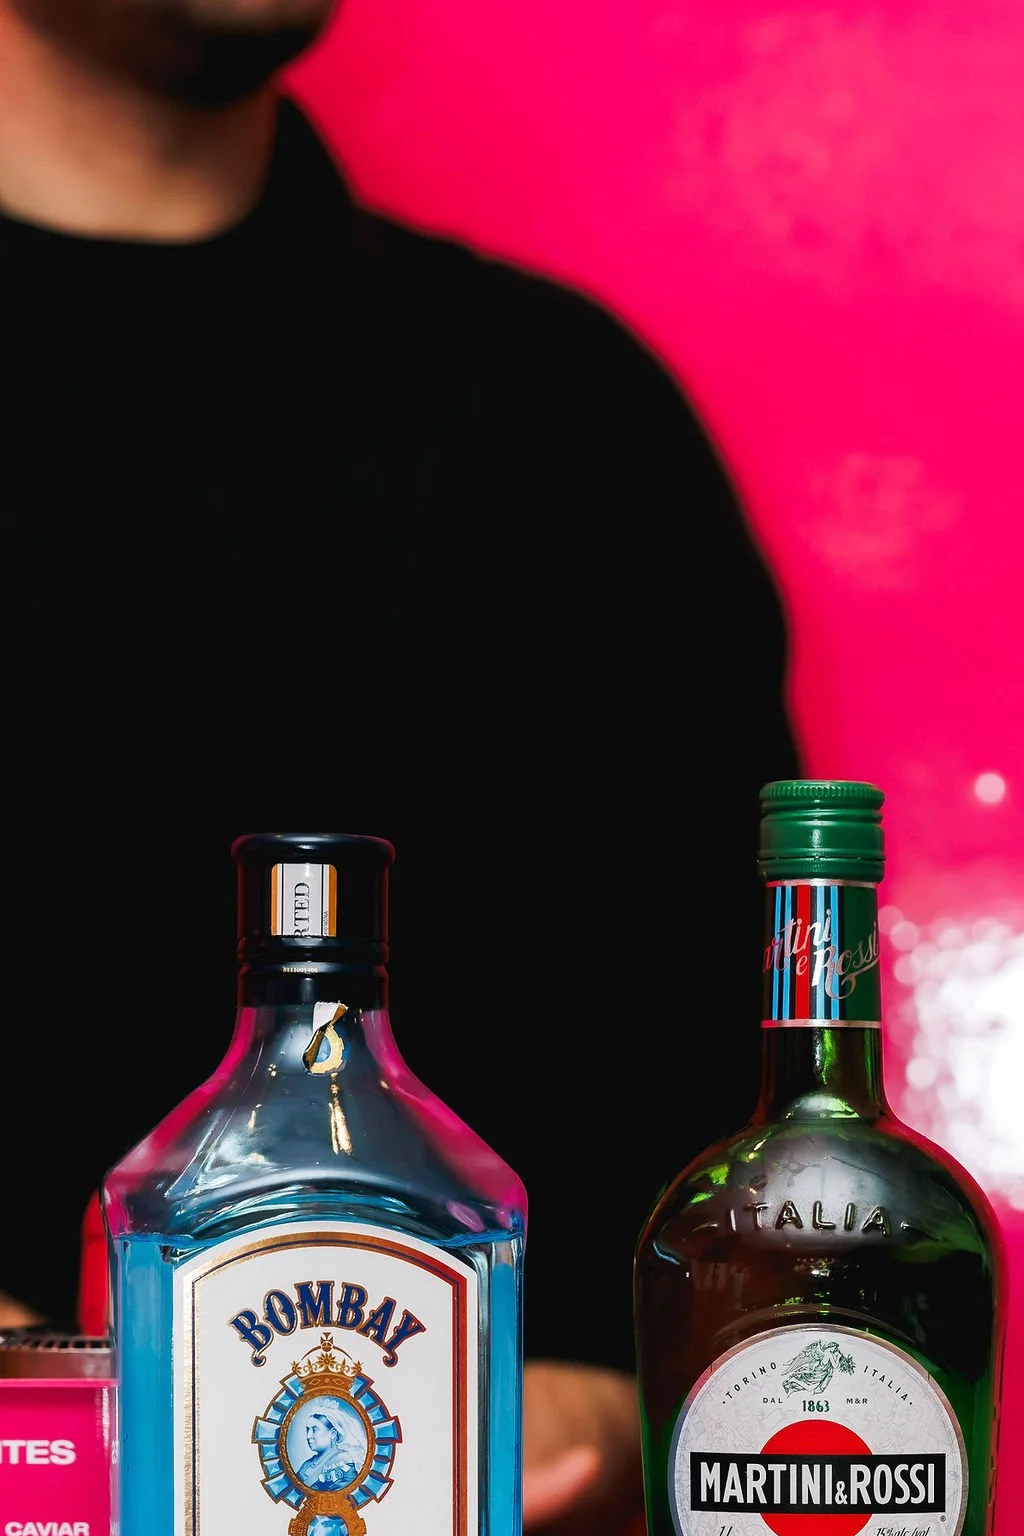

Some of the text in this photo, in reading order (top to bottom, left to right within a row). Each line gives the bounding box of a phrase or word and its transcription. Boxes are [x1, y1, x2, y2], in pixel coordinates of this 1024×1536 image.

[729, 1200, 892, 1236] ITALIA
[230, 1281, 427, 1368] BOMBAY
[725, 1361, 777, 1399] TORINO
[863, 1365, 909, 1401] ITALIA
[802, 1400, 830, 1412] 1863
[0, 1439, 76, 1465] TES
